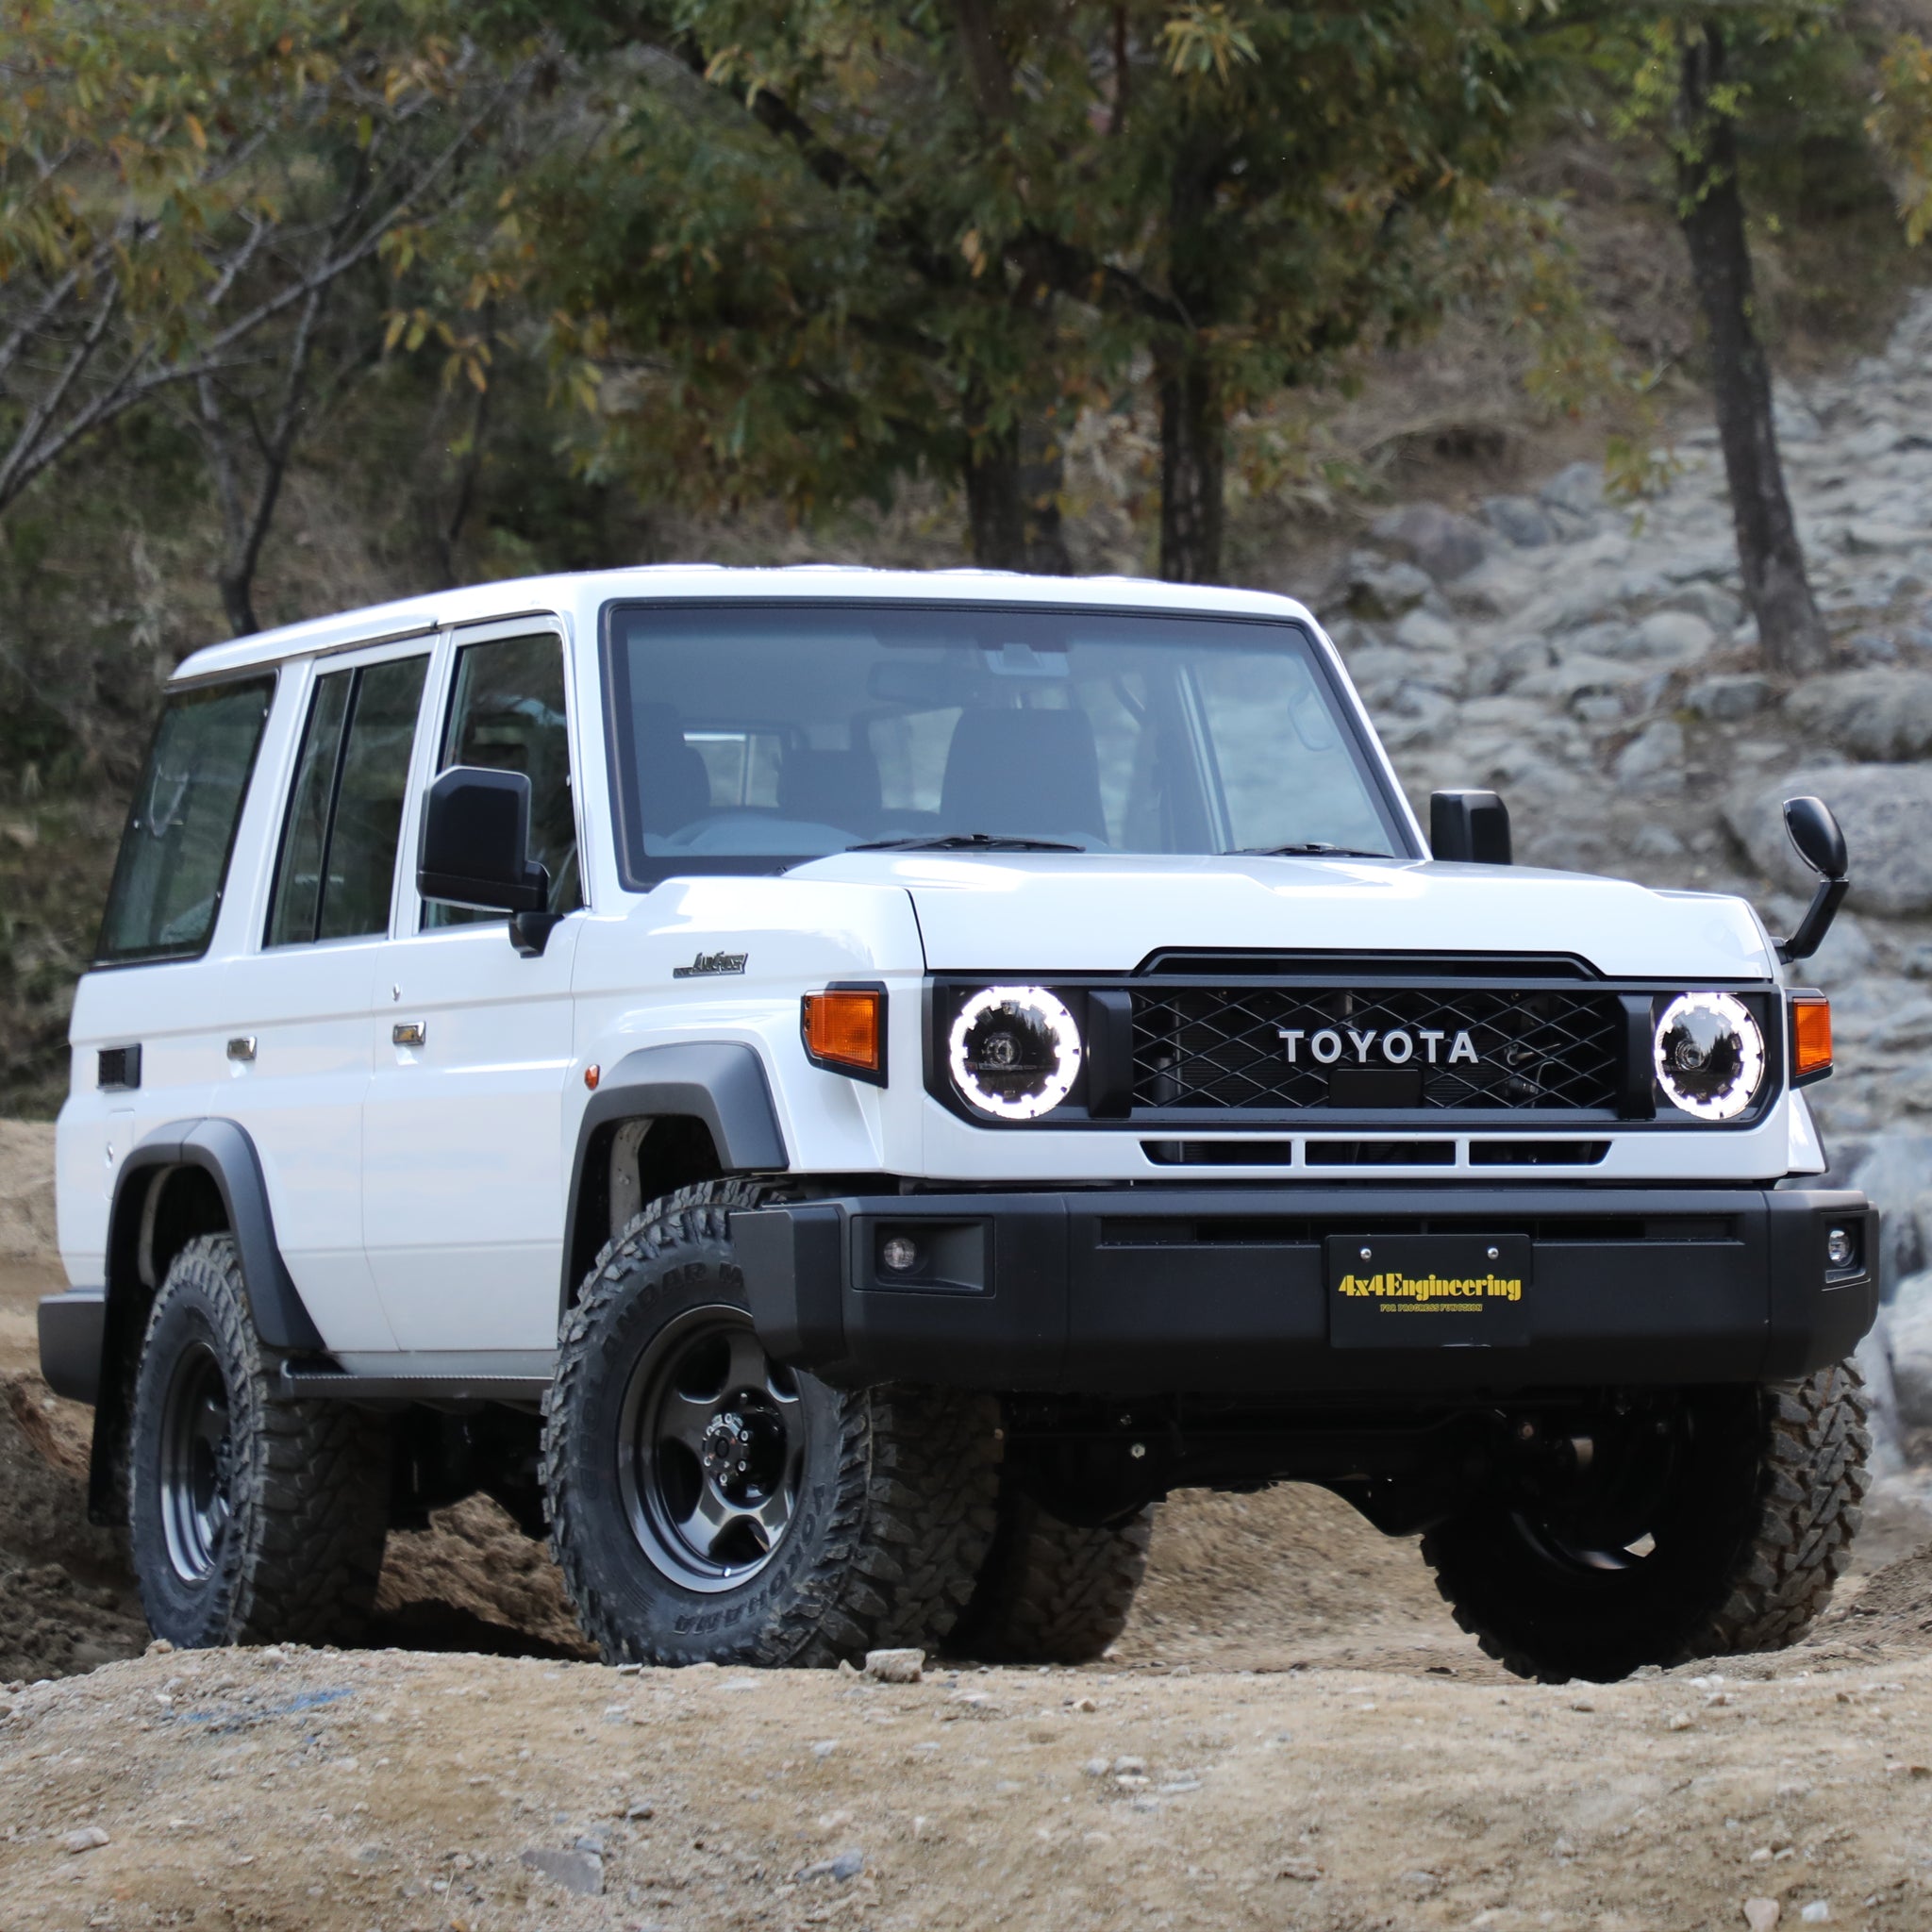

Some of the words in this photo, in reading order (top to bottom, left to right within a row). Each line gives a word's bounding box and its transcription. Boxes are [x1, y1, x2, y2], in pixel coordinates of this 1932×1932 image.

[1278, 1029, 1479, 1064] TOYOTA
[1338, 1273, 1522, 1301] 4x4Engineering
[1379, 1304, 1397, 1312] FOR
[1397, 1304, 1440, 1312] PROGRESS
[673, 1484, 826, 1635] YOKOHAMA
